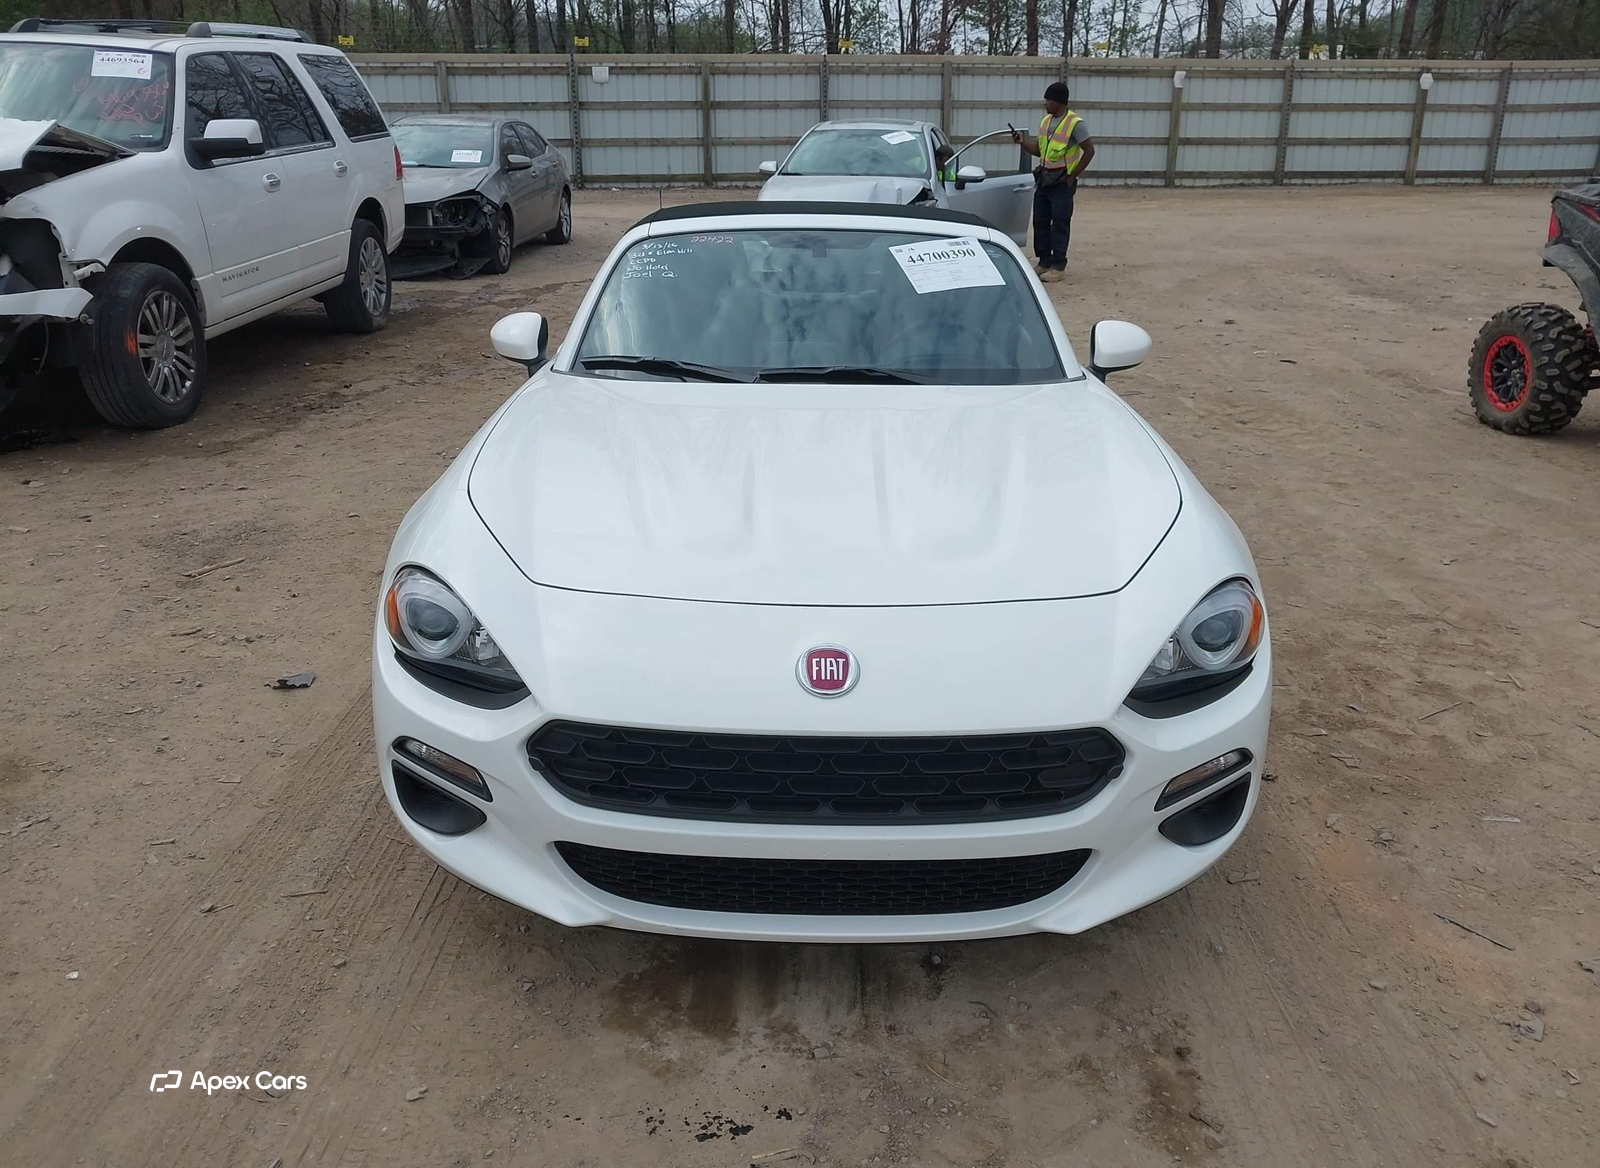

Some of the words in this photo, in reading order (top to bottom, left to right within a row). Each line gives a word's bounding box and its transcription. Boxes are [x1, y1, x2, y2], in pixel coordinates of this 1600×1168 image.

[99, 56, 145, 64] 44693564
[691, 236, 734, 244] 22422
[907, 247, 976, 264] 44700390
[222, 266, 260, 283] NAVIGATOR
[812, 657, 846, 681] FIAT
